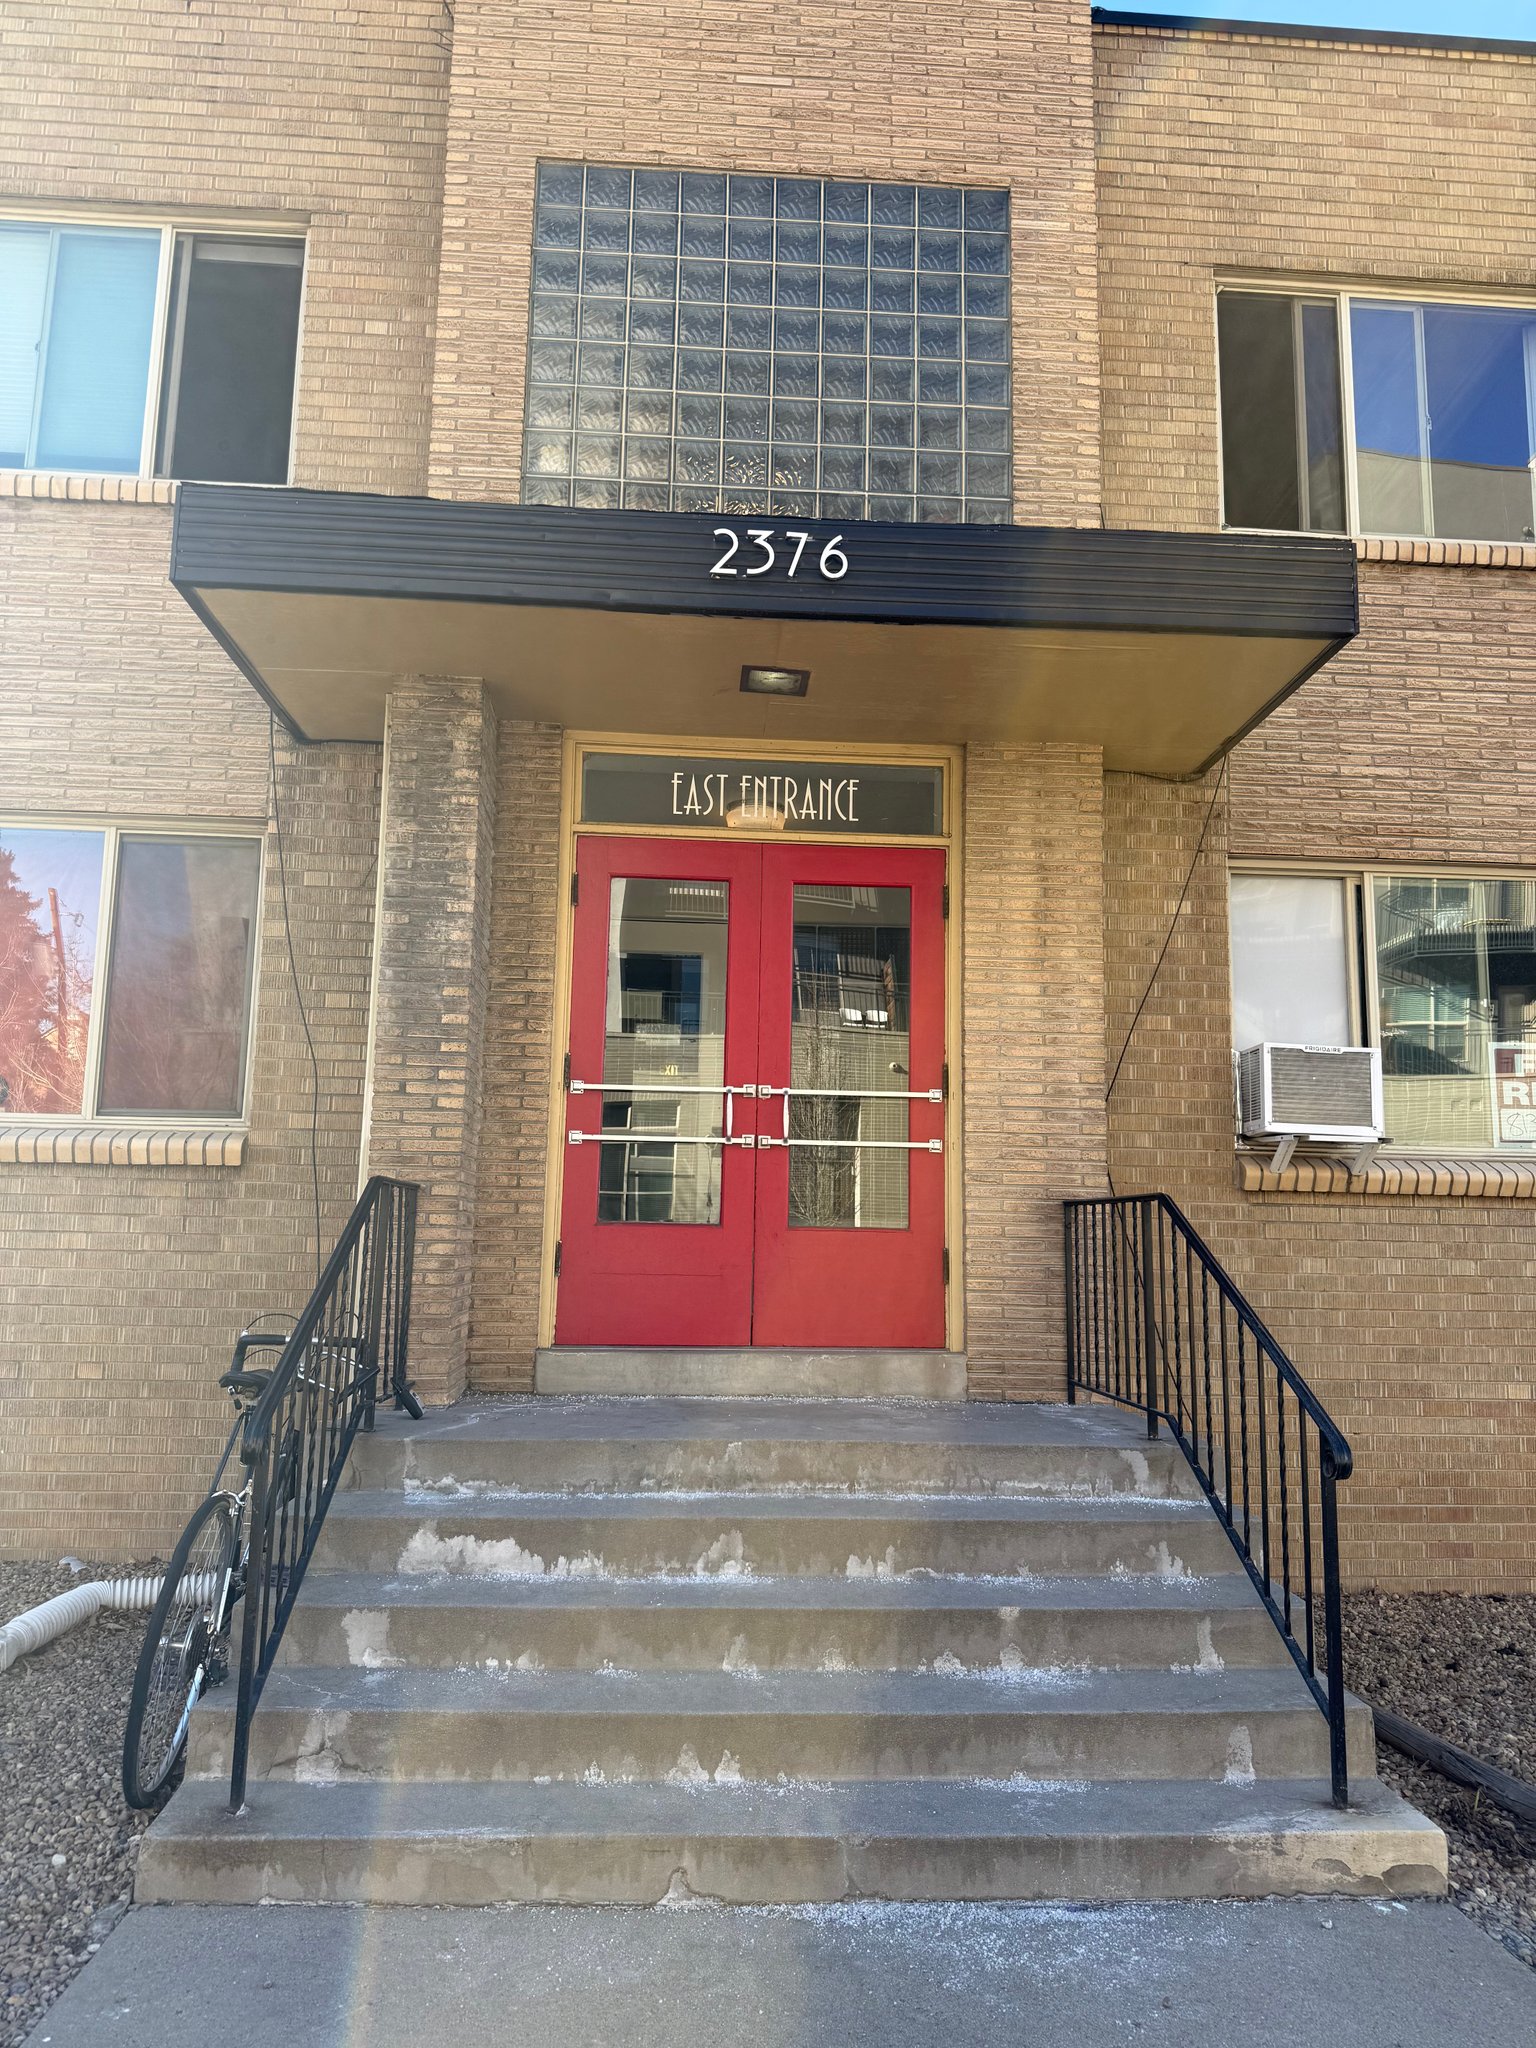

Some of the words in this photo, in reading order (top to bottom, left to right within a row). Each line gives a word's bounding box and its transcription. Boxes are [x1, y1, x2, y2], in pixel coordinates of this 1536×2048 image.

[709, 528, 848, 579] 2376
[671, 772, 728, 817] EAST
[740, 775, 860, 822] ENTRANCE
[1304, 1045, 1341, 1053] FRIGIDAIRE
